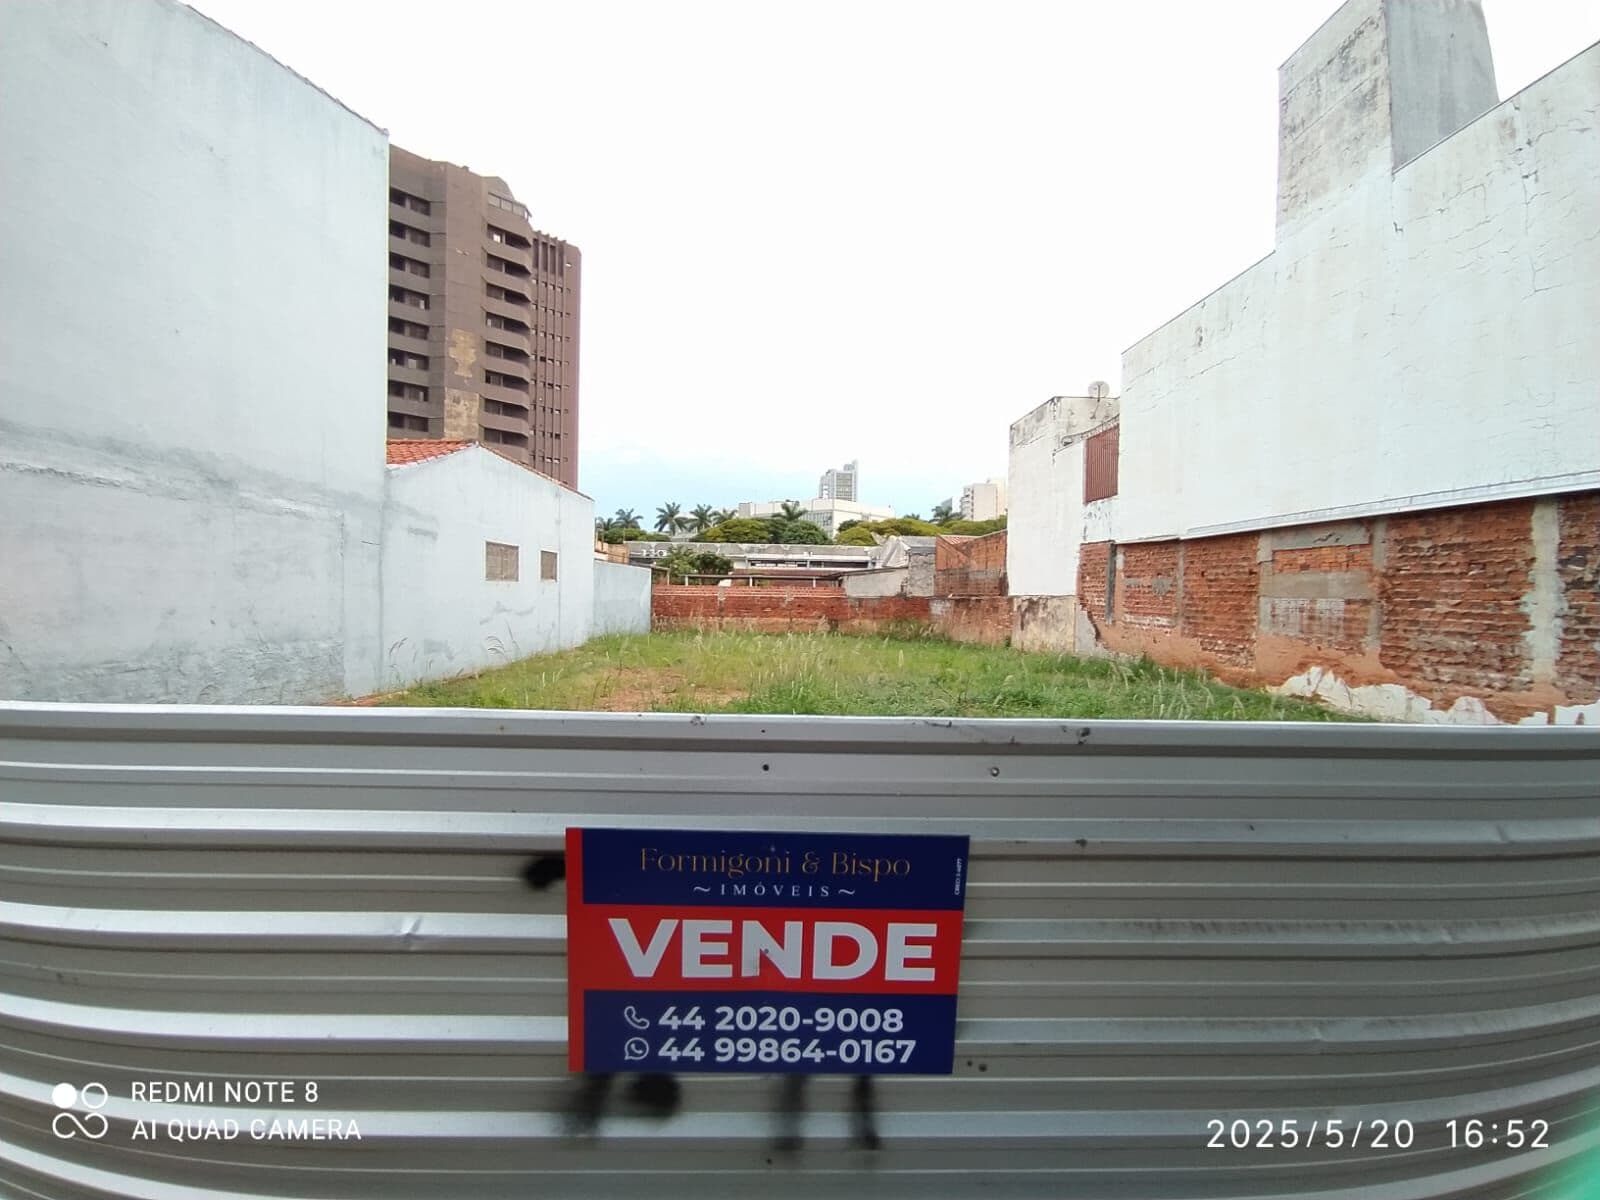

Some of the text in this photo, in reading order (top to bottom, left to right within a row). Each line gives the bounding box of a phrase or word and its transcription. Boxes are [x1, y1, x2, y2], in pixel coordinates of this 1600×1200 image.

[640, 847, 911, 882] Formigoni & Bispo
[608, 918, 938, 982] VENDE
[658, 1006, 904, 1033] 44 2020-9008
[658, 1037, 916, 1064] 44 99864-0167
